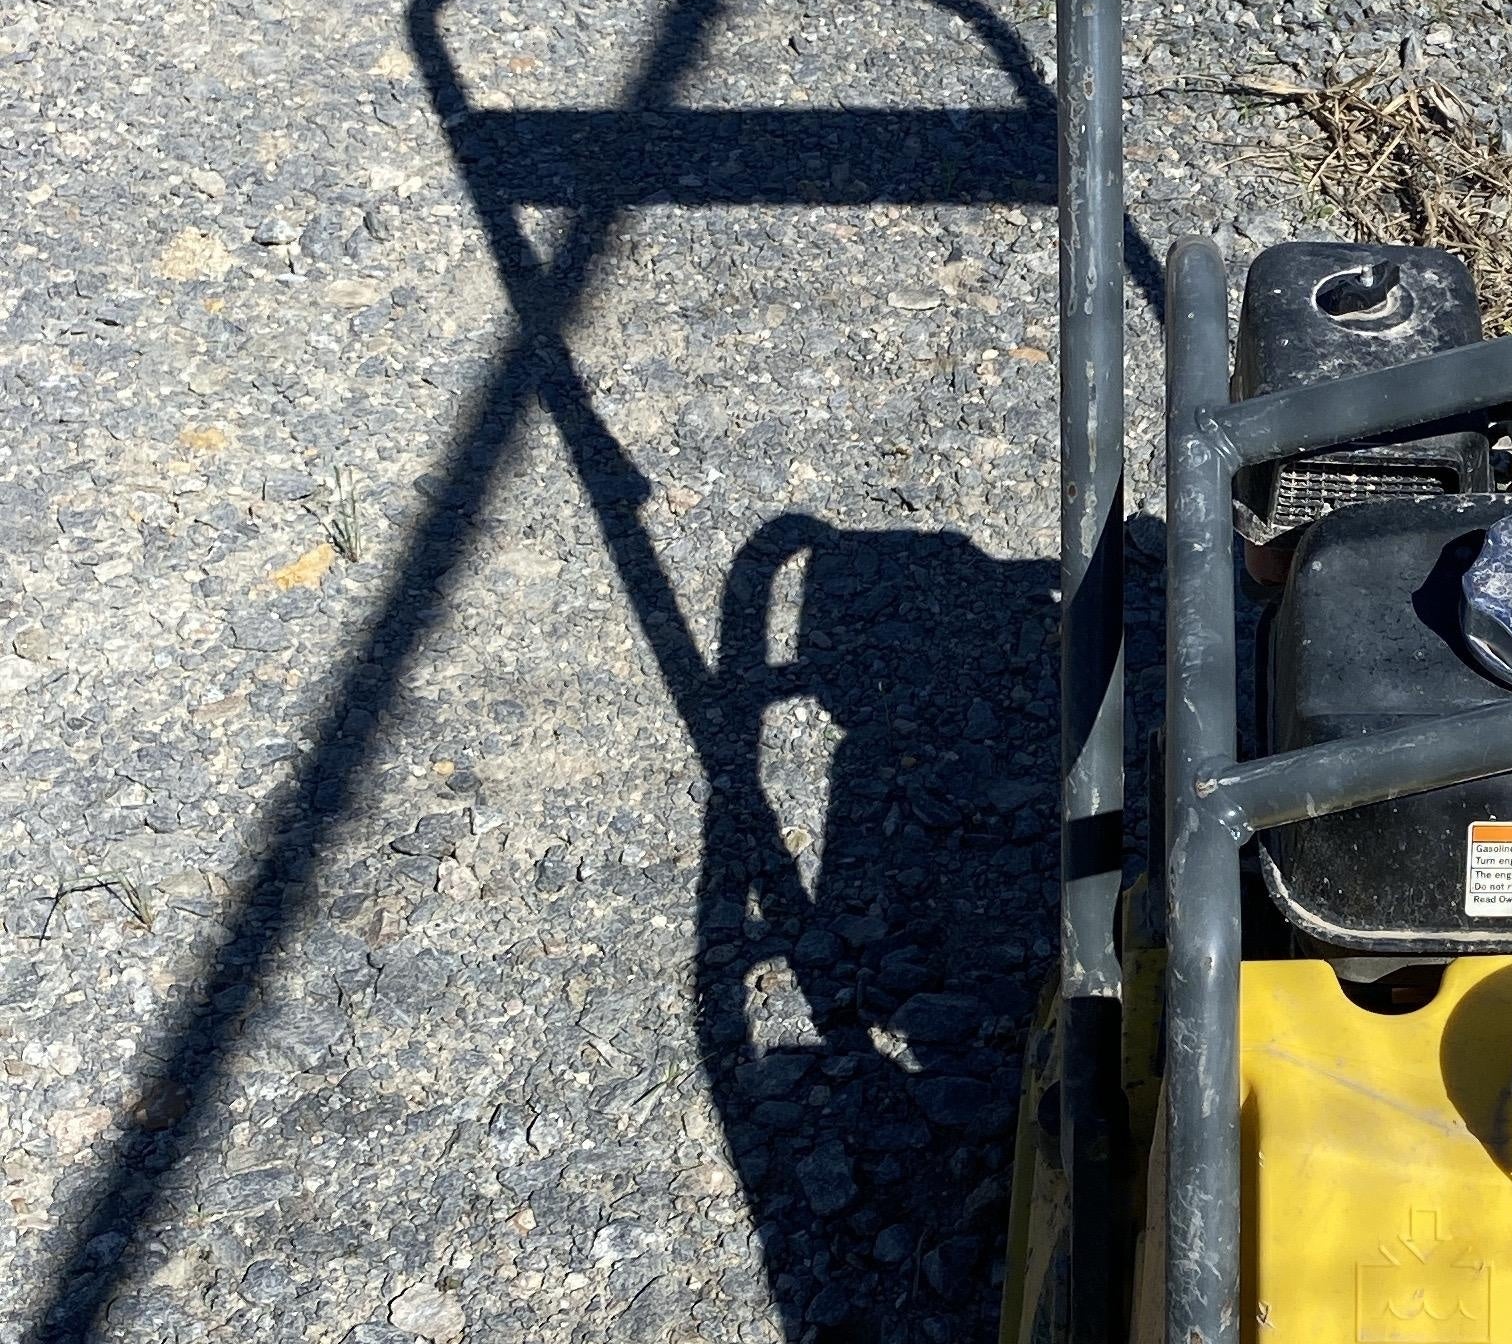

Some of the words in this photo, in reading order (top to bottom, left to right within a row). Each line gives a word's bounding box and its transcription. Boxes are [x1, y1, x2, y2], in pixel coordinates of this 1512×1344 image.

[1475, 856, 1496, 865] Turn
[1475, 870, 1492, 879] The
[1474, 882, 1487, 891] Do
[1489, 883, 1505, 891] not
[1473, 895, 1497, 904] Read
